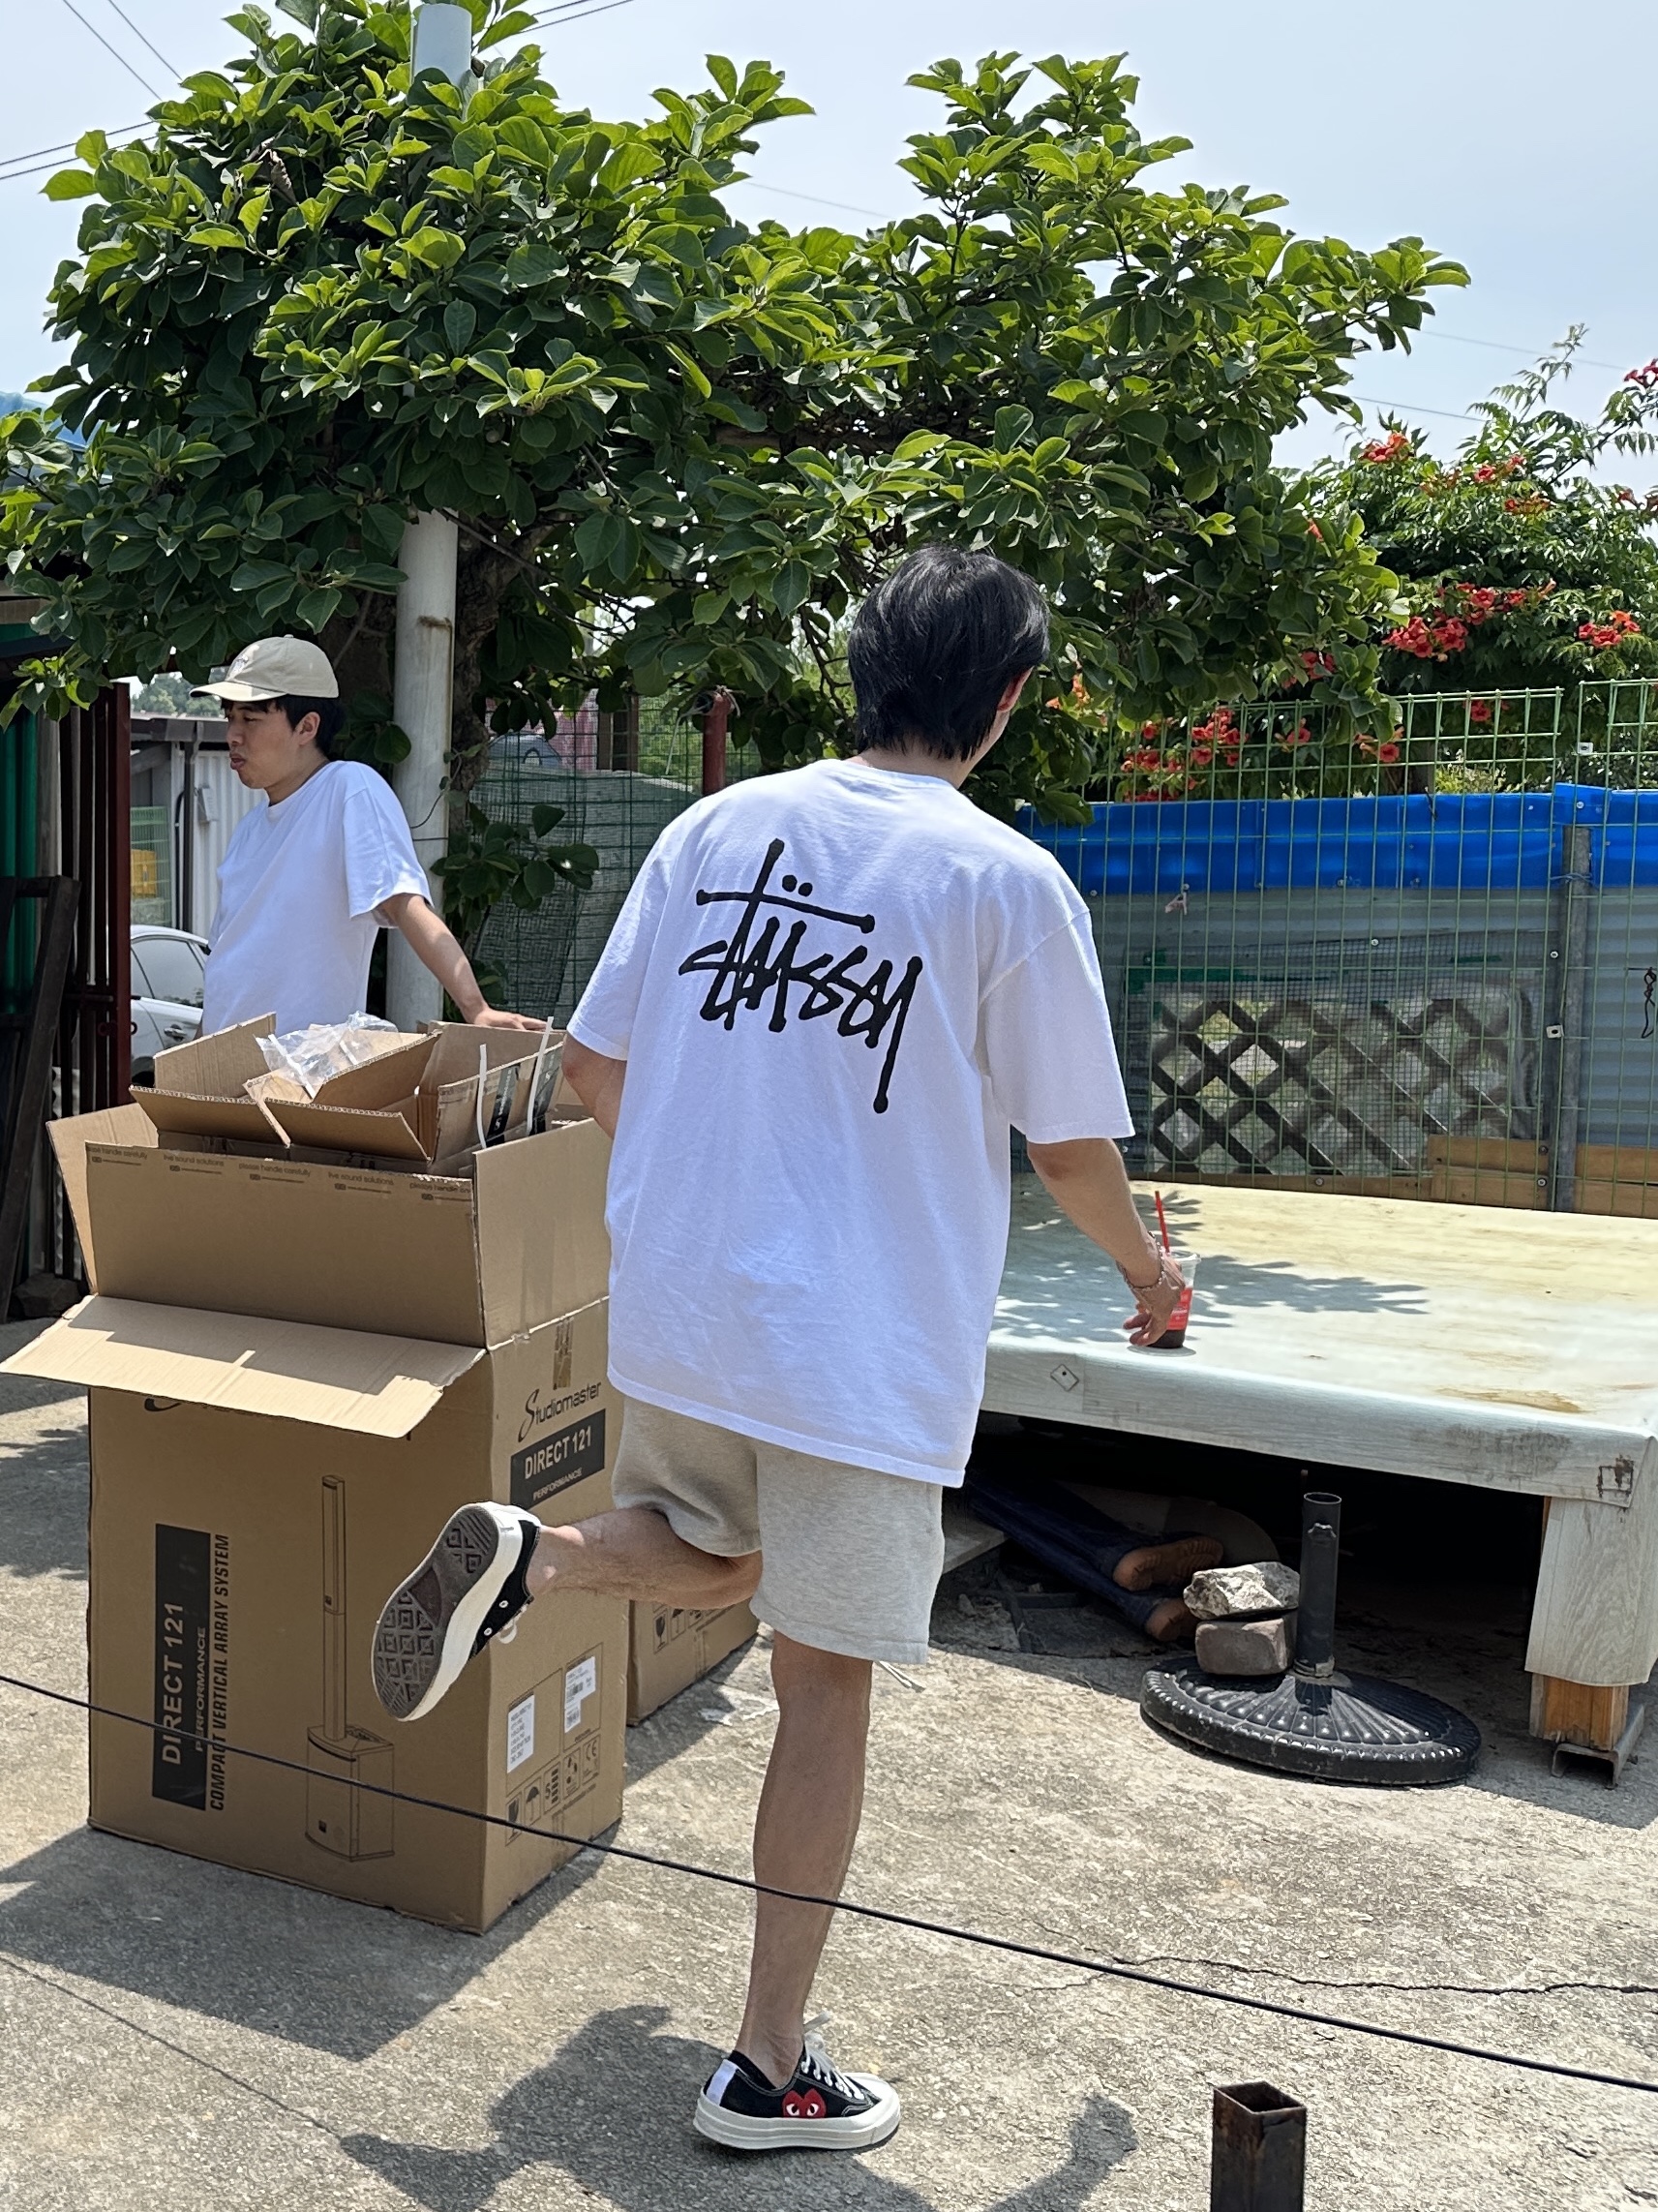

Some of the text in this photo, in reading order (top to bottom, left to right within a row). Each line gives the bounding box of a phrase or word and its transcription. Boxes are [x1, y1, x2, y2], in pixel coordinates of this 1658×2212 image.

[518, 1381, 602, 1443] Studiomaster
[525, 1425, 591, 1480] DIRECT 121
[532, 1467, 583, 1501] PERFORMANCE
[162, 1603, 183, 1765] DIRECT 121
[196, 1626, 206, 1752] PERFORMANCE
[210, 1533, 229, 1811] COMPACT VERTICAL ARRAY SYSTEM
